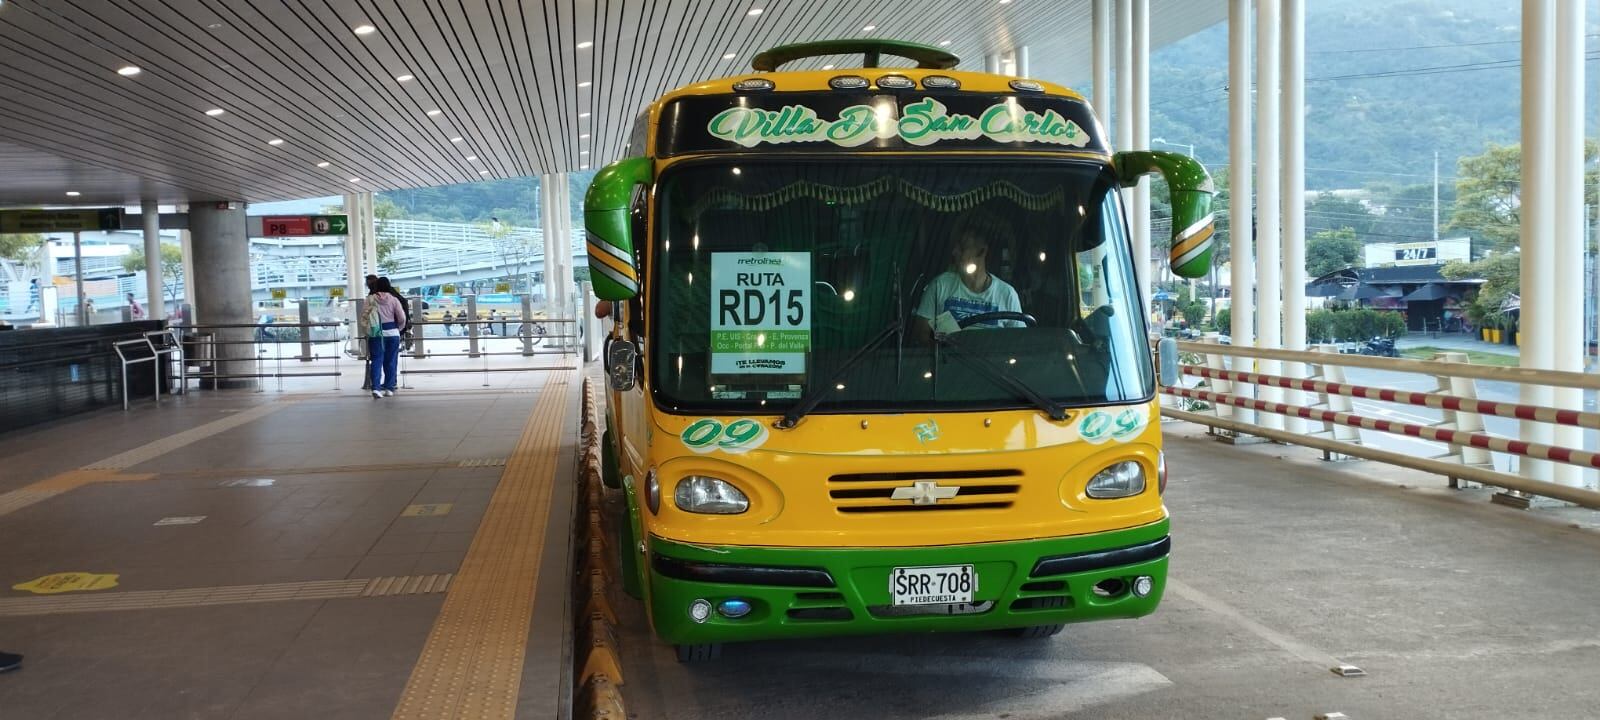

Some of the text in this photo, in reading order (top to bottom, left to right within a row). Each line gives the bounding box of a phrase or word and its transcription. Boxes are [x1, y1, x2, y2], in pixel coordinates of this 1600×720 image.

[709, 104, 821, 139] Villa
[898, 98, 974, 142] San
[270, 223, 287, 236] P8
[1403, 247, 1428, 260] 24/7
[736, 273, 785, 286] RUTA
[719, 289, 804, 326] RD15
[681, 418, 763, 448] 09
[1078, 408, 1142, 438] 09
[910, 595, 957, 603] PIEDECUESTA
